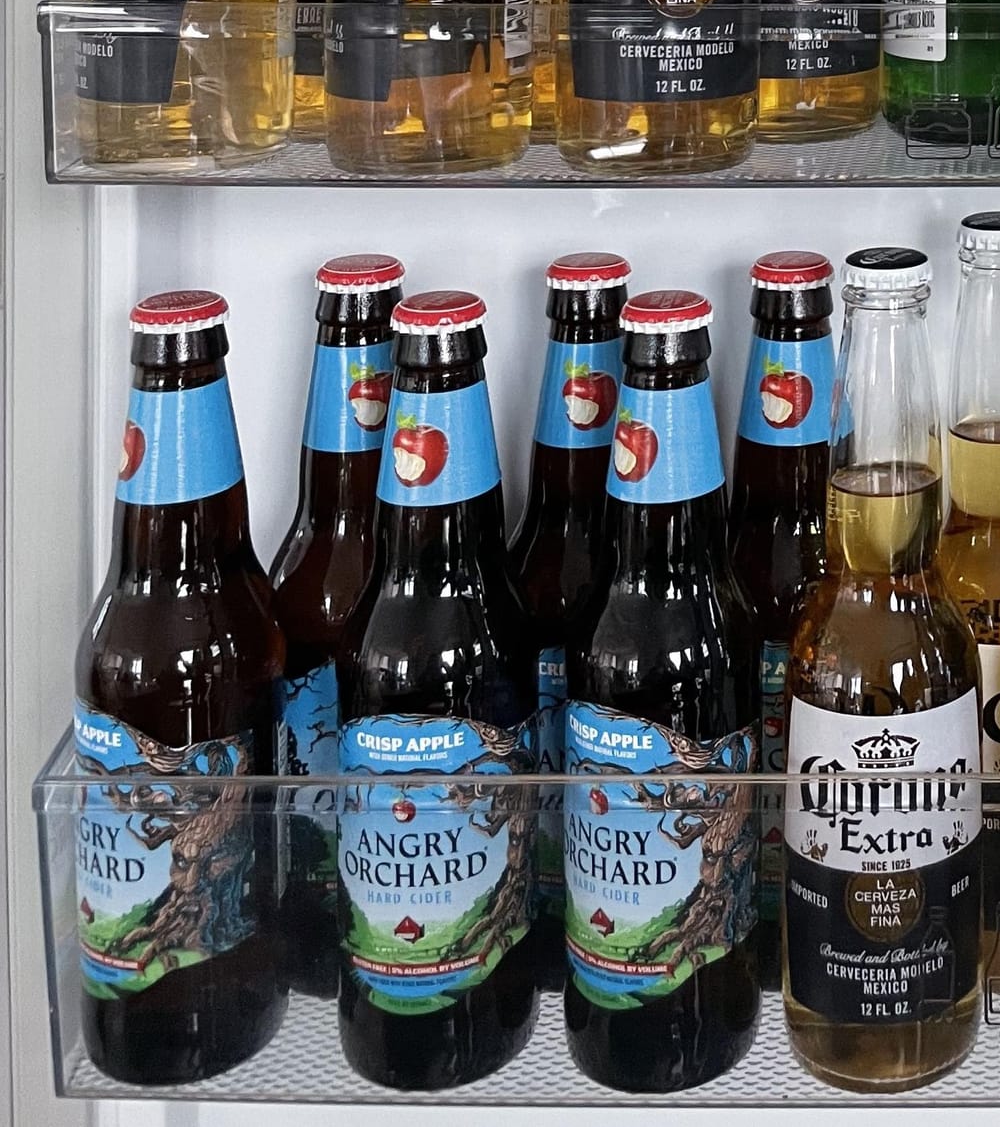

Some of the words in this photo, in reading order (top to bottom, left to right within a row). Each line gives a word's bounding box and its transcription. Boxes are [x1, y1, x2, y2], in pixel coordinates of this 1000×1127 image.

[620, 42, 692, 59] CERVECERIA
[695, 40, 735, 56] MODELO
[788, 38, 830, 52] MEXICO
[658, 57, 704, 72] MEXICO
[786, 60, 798, 73] 12
[655, 79, 668, 93] 12
[82, 725, 122, 748] APPLE
[569, 712, 599, 741] CRISP
[600, 729, 653, 750] APPLE
[356, 731, 403, 753] CRISP
[405, 731, 465, 753] APPLE
[356, 826, 464, 861] ANGRY
[568, 814, 653, 857] ANGRY
[839, 816, 934, 856] Extra
[344, 850, 488, 888] ORCHARD
[565, 837, 678, 887] ORCHARD
[860, 859, 888, 873] SINCE
[791, 878, 829, 910] IMPORTED
[876, 878, 896, 891] LA
[951, 875, 970, 899] BEER
[366, 889, 401, 905] HARD
[409, 889, 453, 905] CIDER
[603, 887, 641, 907] CIDER
[853, 889, 917, 906] CERVEZA
[870, 904, 901, 918] MAS
[869, 916, 902, 930] FINA
[819, 942, 862, 964] Brewed
[864, 949, 889, 965] and
[826, 961, 898, 983] CERVECERIA
[862, 980, 909, 996] MEXICO
[860, 1002, 874, 1017] 12
[876, 1002, 891, 1017] FL.
[894, 1000, 912, 1016] OZ.
